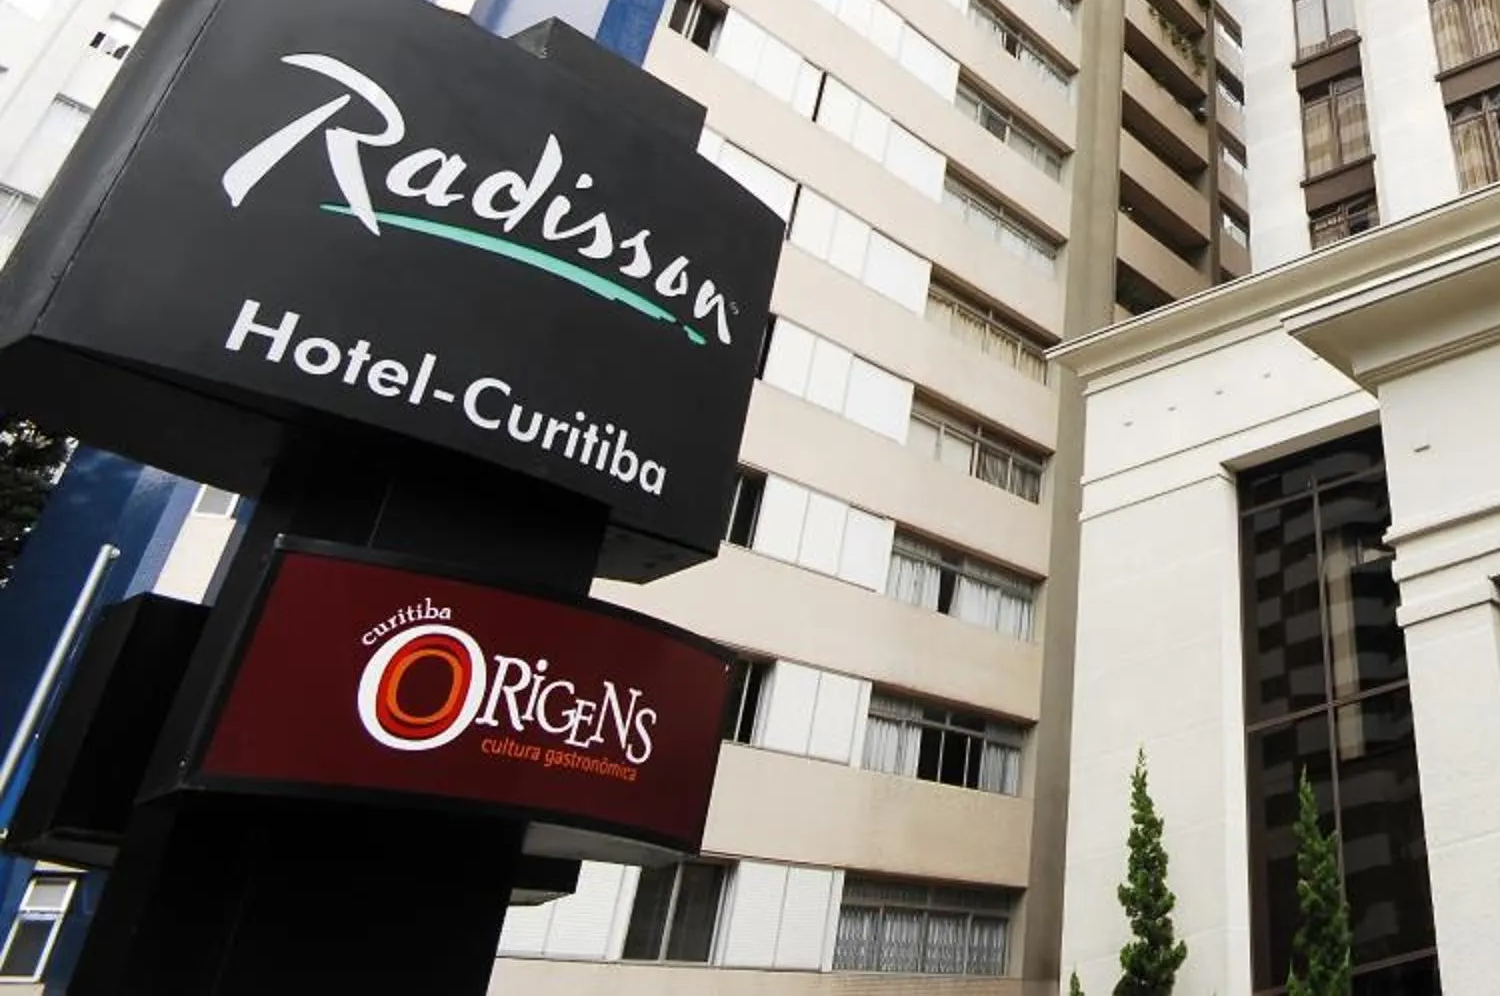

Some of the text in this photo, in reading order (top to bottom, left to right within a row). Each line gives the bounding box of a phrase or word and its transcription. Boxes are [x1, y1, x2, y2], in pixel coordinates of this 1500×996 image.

[221, 53, 733, 346] Radisson
[224, 299, 667, 496] Hotel-Curitiba
[361, 597, 452, 646] curitiba
[481, 737, 638, 782] cultura gastronômica
